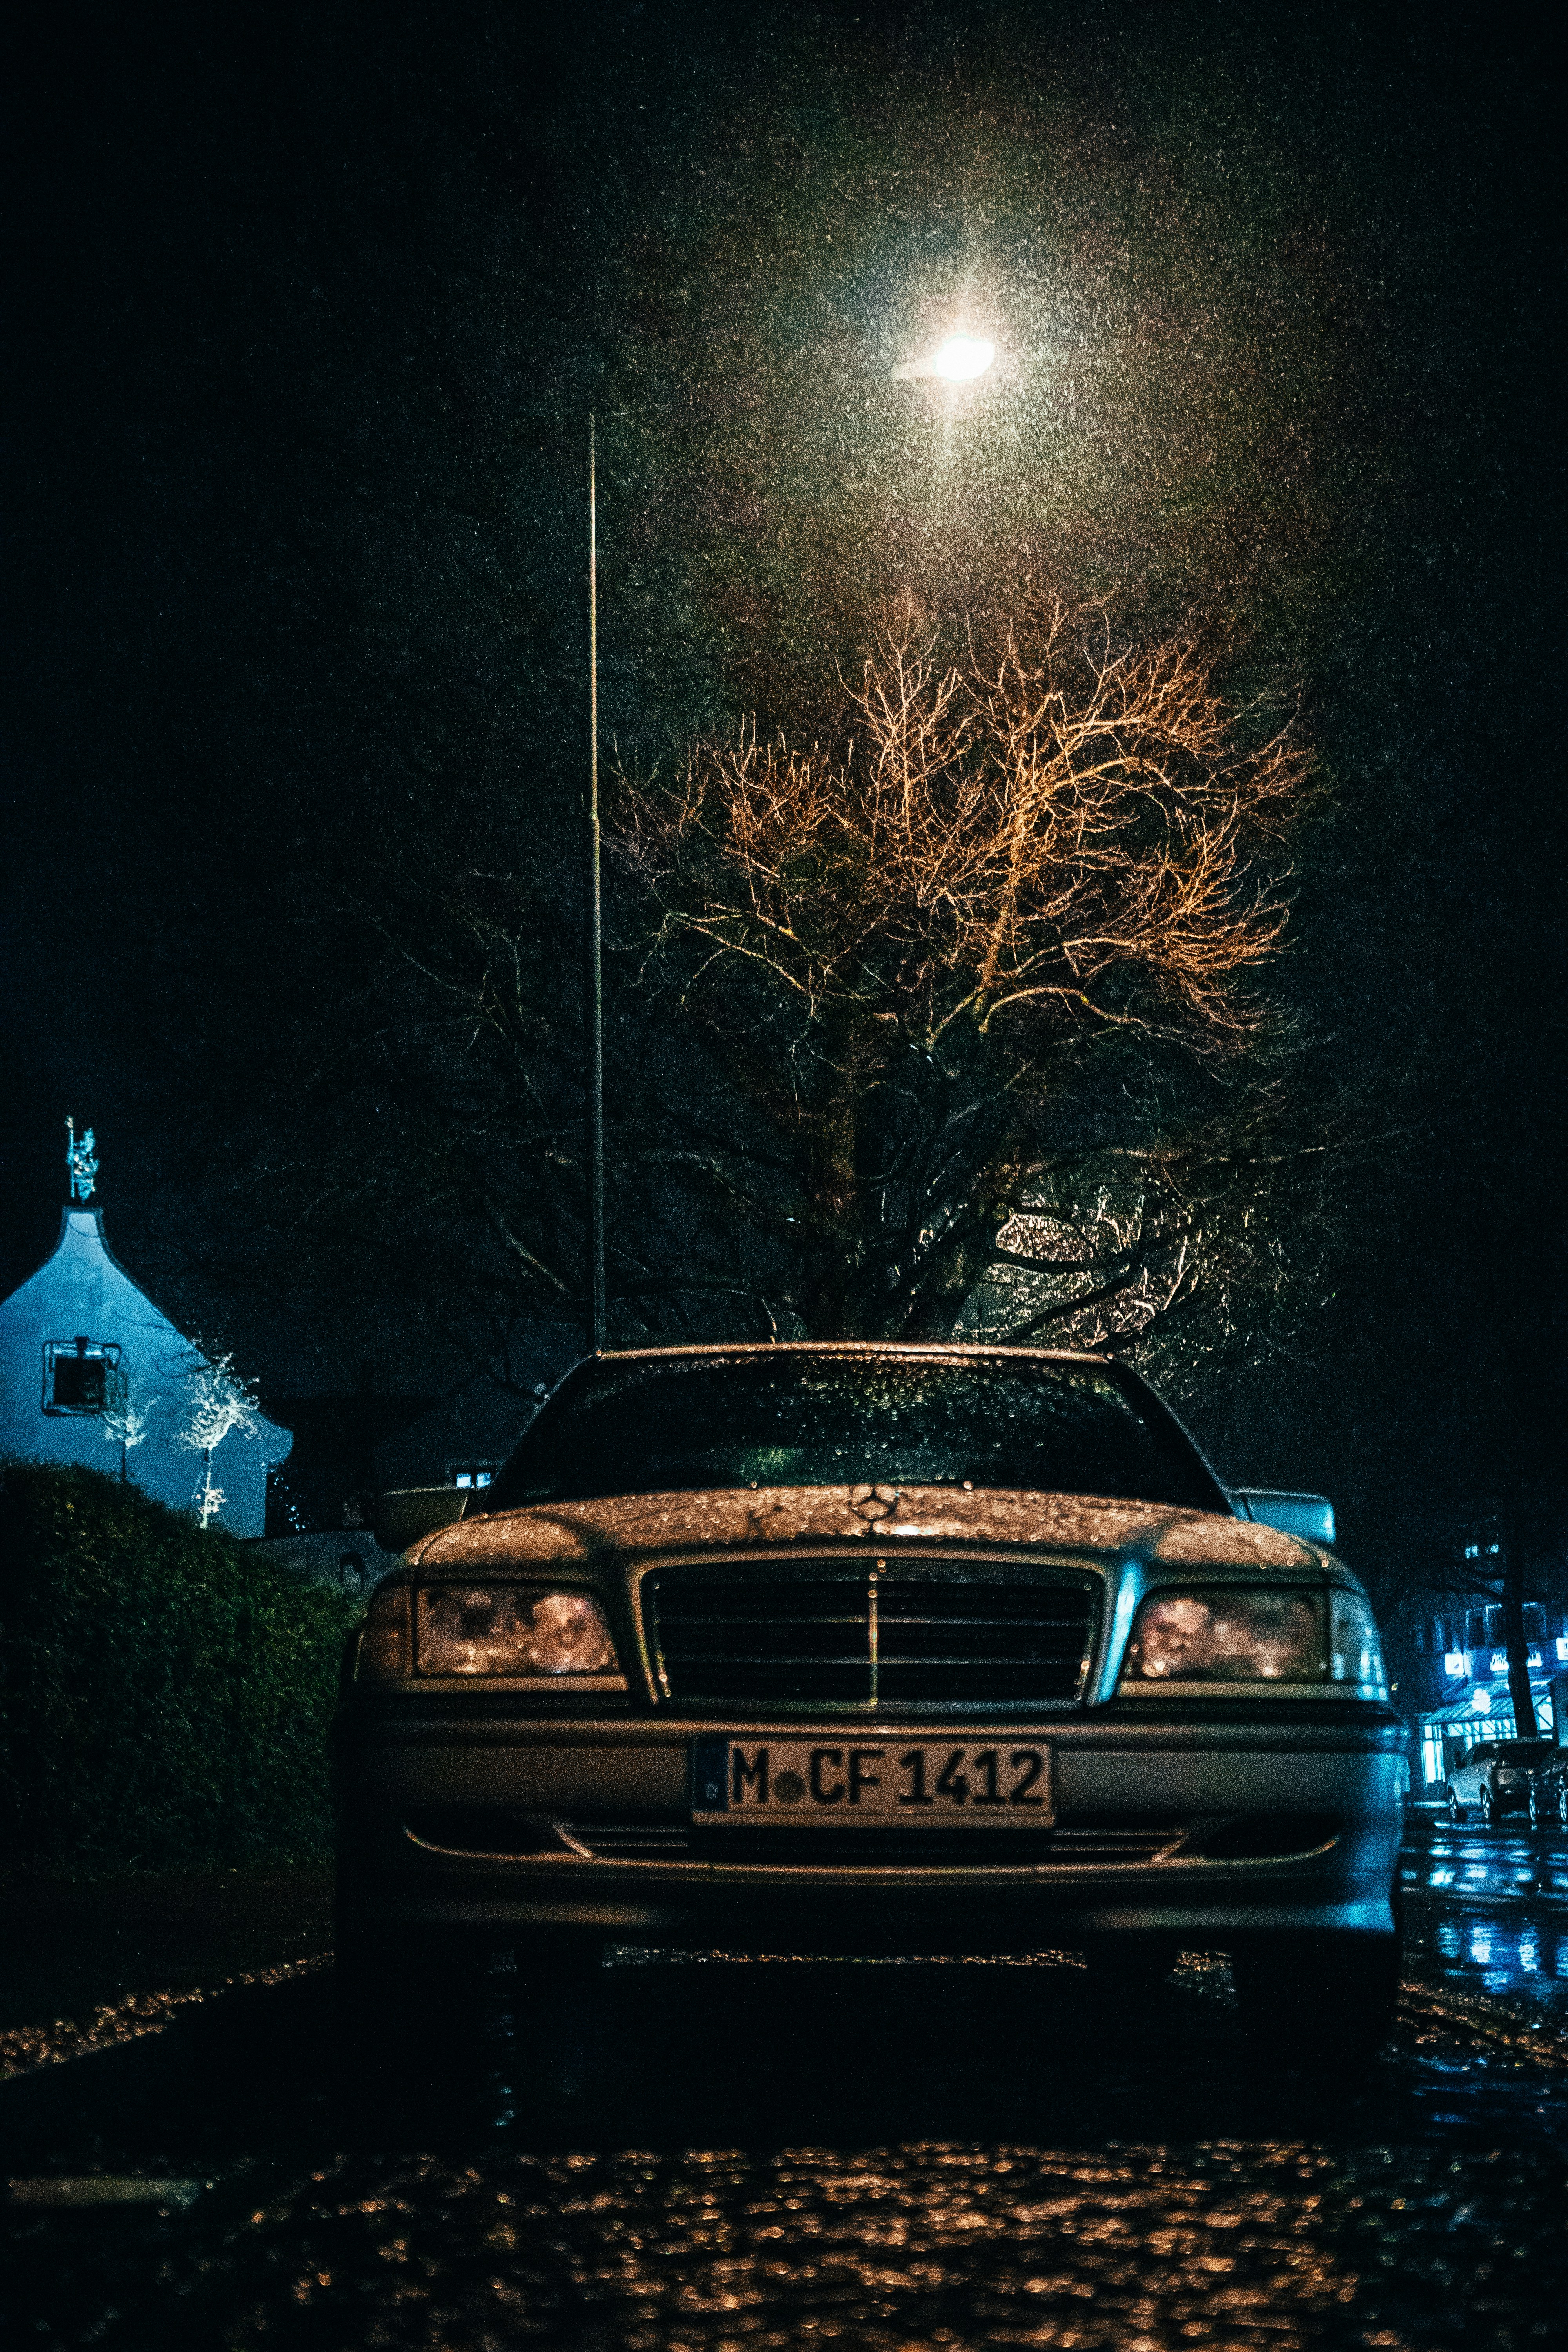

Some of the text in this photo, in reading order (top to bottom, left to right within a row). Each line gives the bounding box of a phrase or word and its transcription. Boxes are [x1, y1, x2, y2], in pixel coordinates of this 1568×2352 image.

[732, 1748, 1043, 1806] M CF 1412
